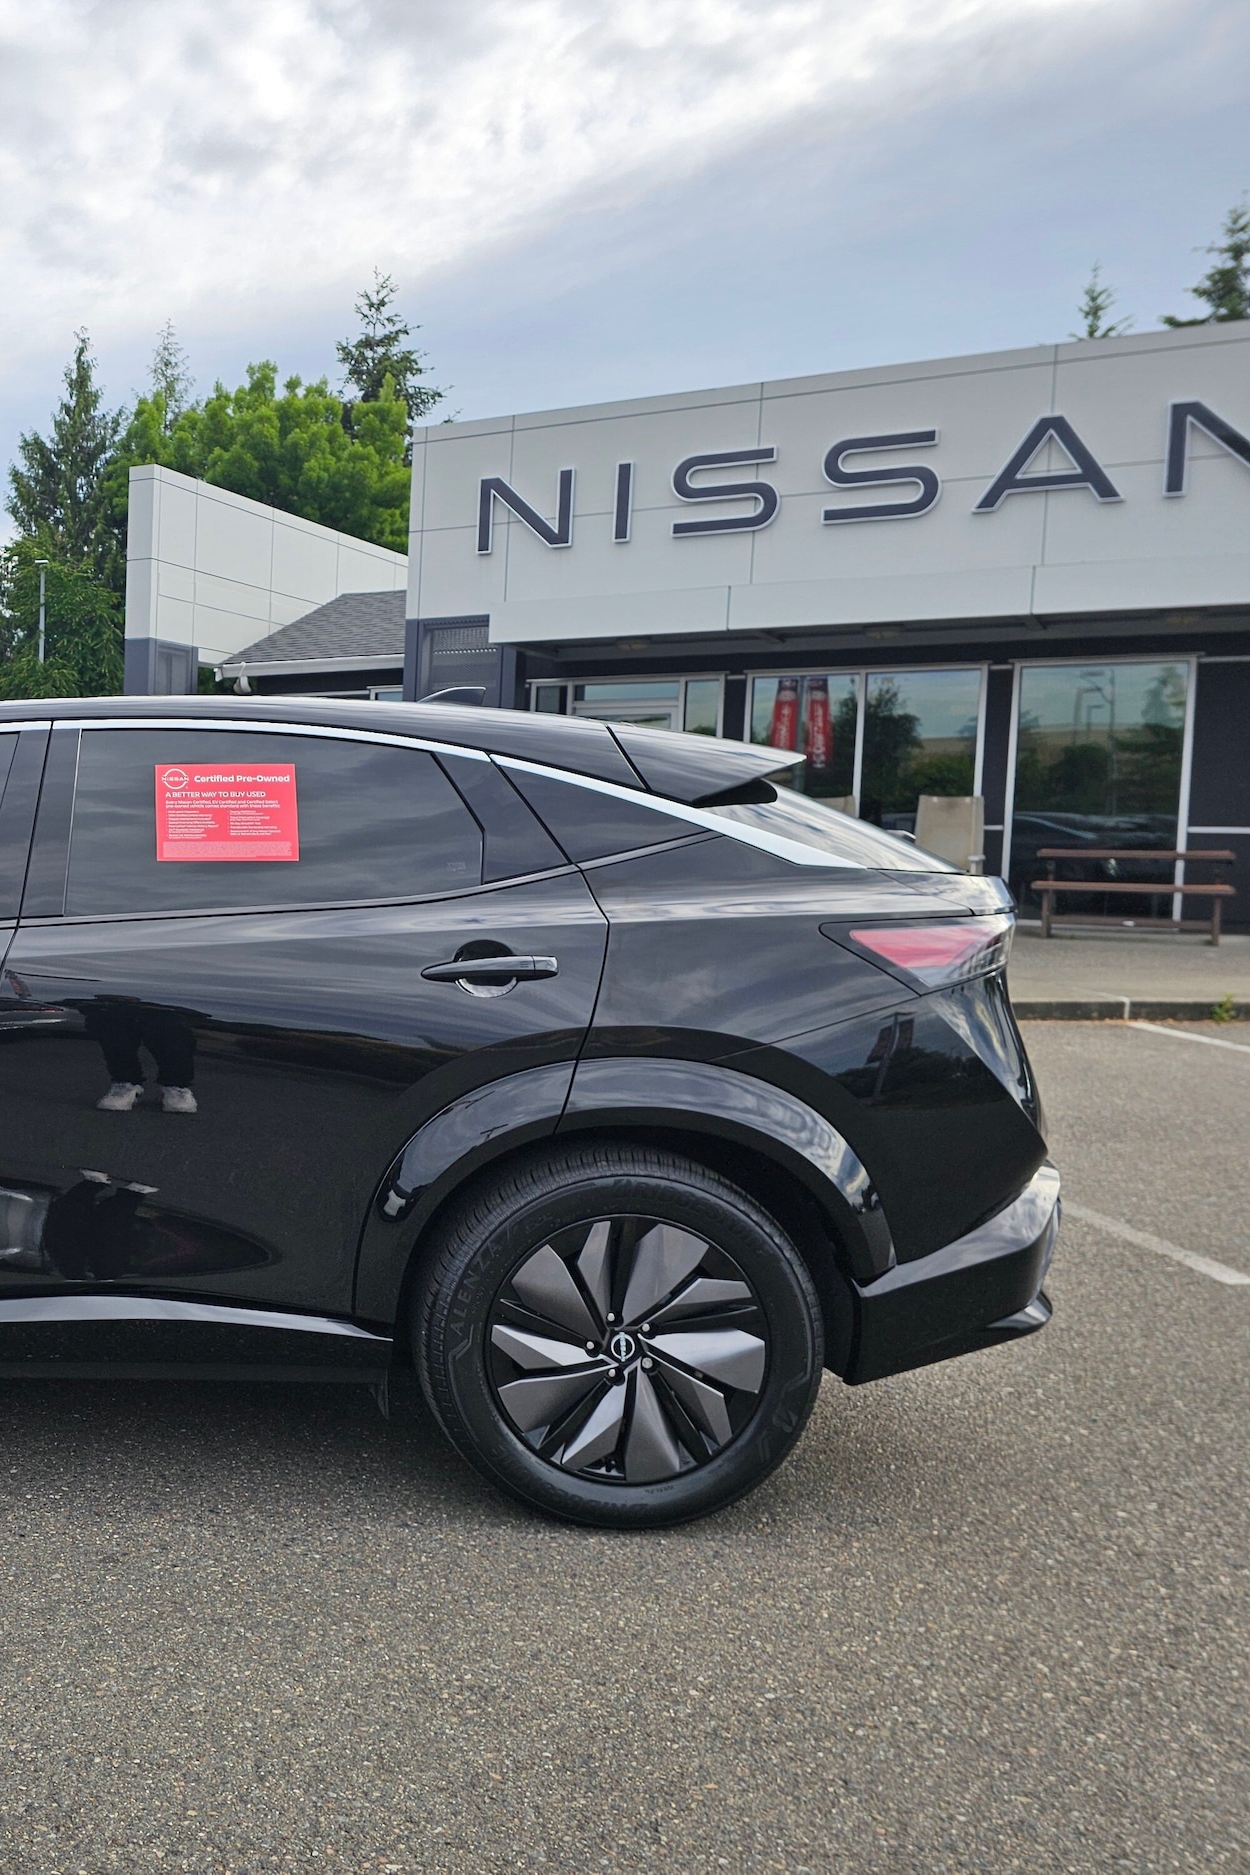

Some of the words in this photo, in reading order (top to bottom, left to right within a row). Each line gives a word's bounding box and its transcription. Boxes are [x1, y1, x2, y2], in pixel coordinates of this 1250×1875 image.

[476, 399, 1250, 555] NISSAN
[194, 774, 235, 783] Certified
[236, 774, 291, 783] Pre-Owned
